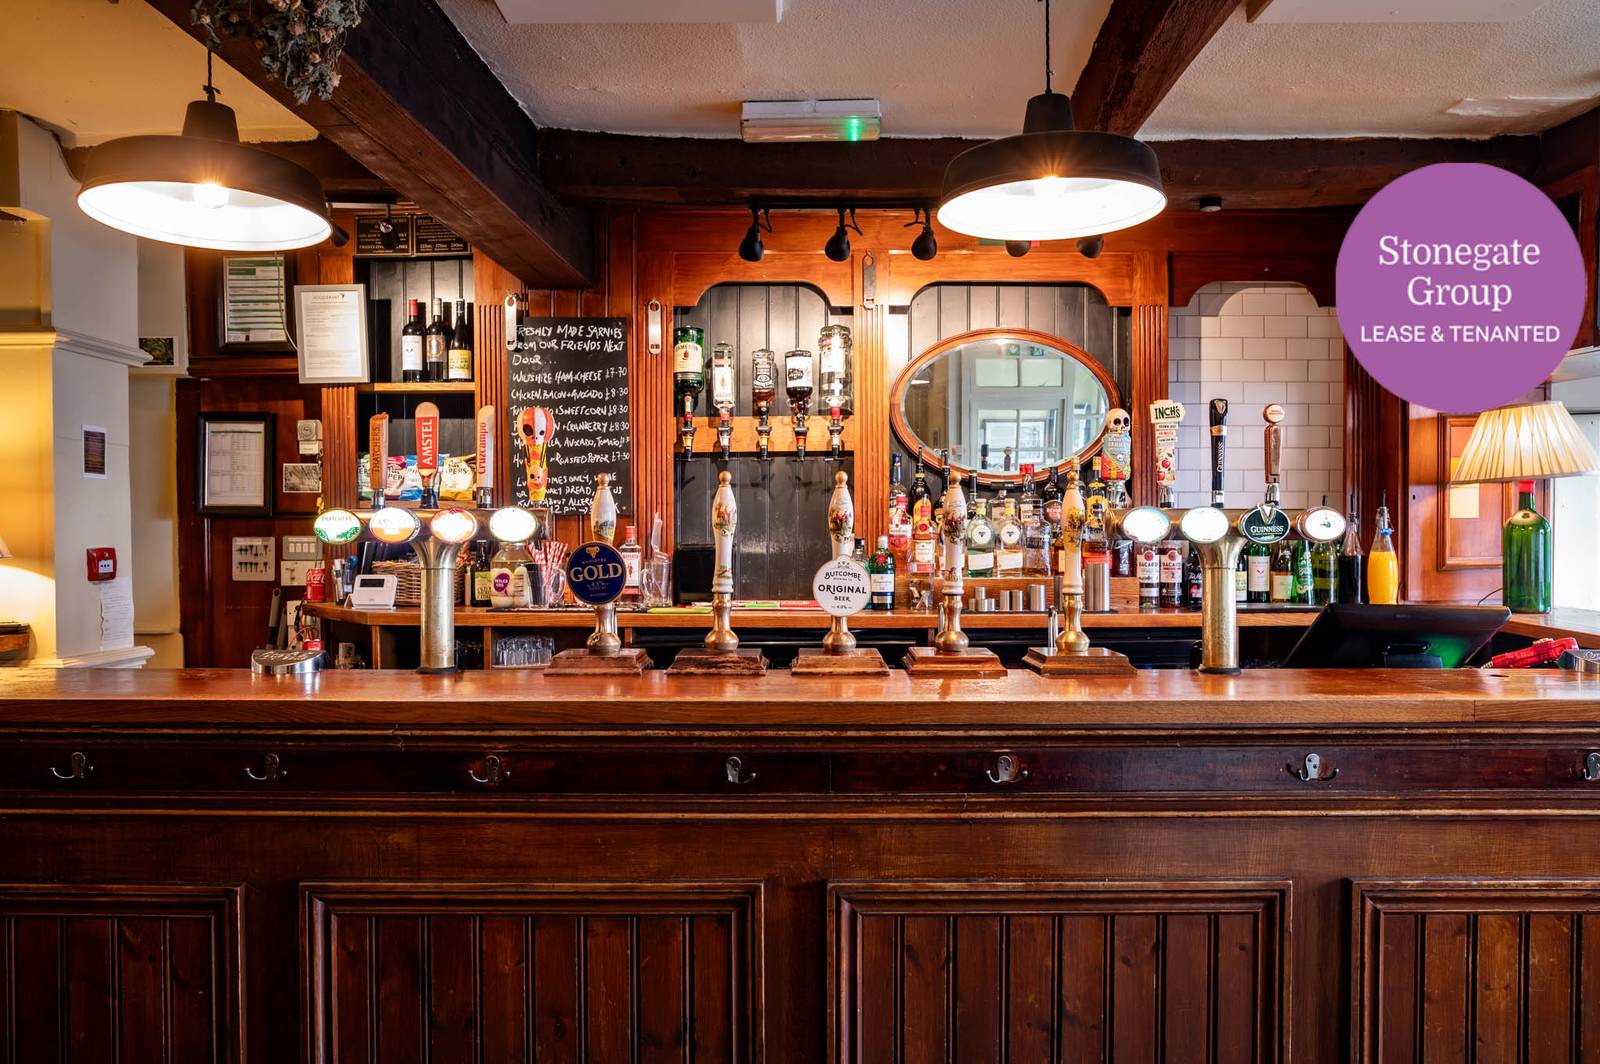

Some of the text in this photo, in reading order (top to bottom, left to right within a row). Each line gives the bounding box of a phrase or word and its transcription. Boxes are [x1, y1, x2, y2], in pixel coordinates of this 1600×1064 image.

[516, 324, 622, 339] RESHLY MADE SARNIES
[516, 339, 626, 352] ROM OUR FRIENDS NEXT
[421, 419, 433, 466] AMSTEL
[1250, 525, 1284, 533] GUINNESS
[570, 563, 622, 582] GOLD
[824, 571, 861, 581] BUTCOMBE
[818, 584, 867, 594] ORIGINAL
